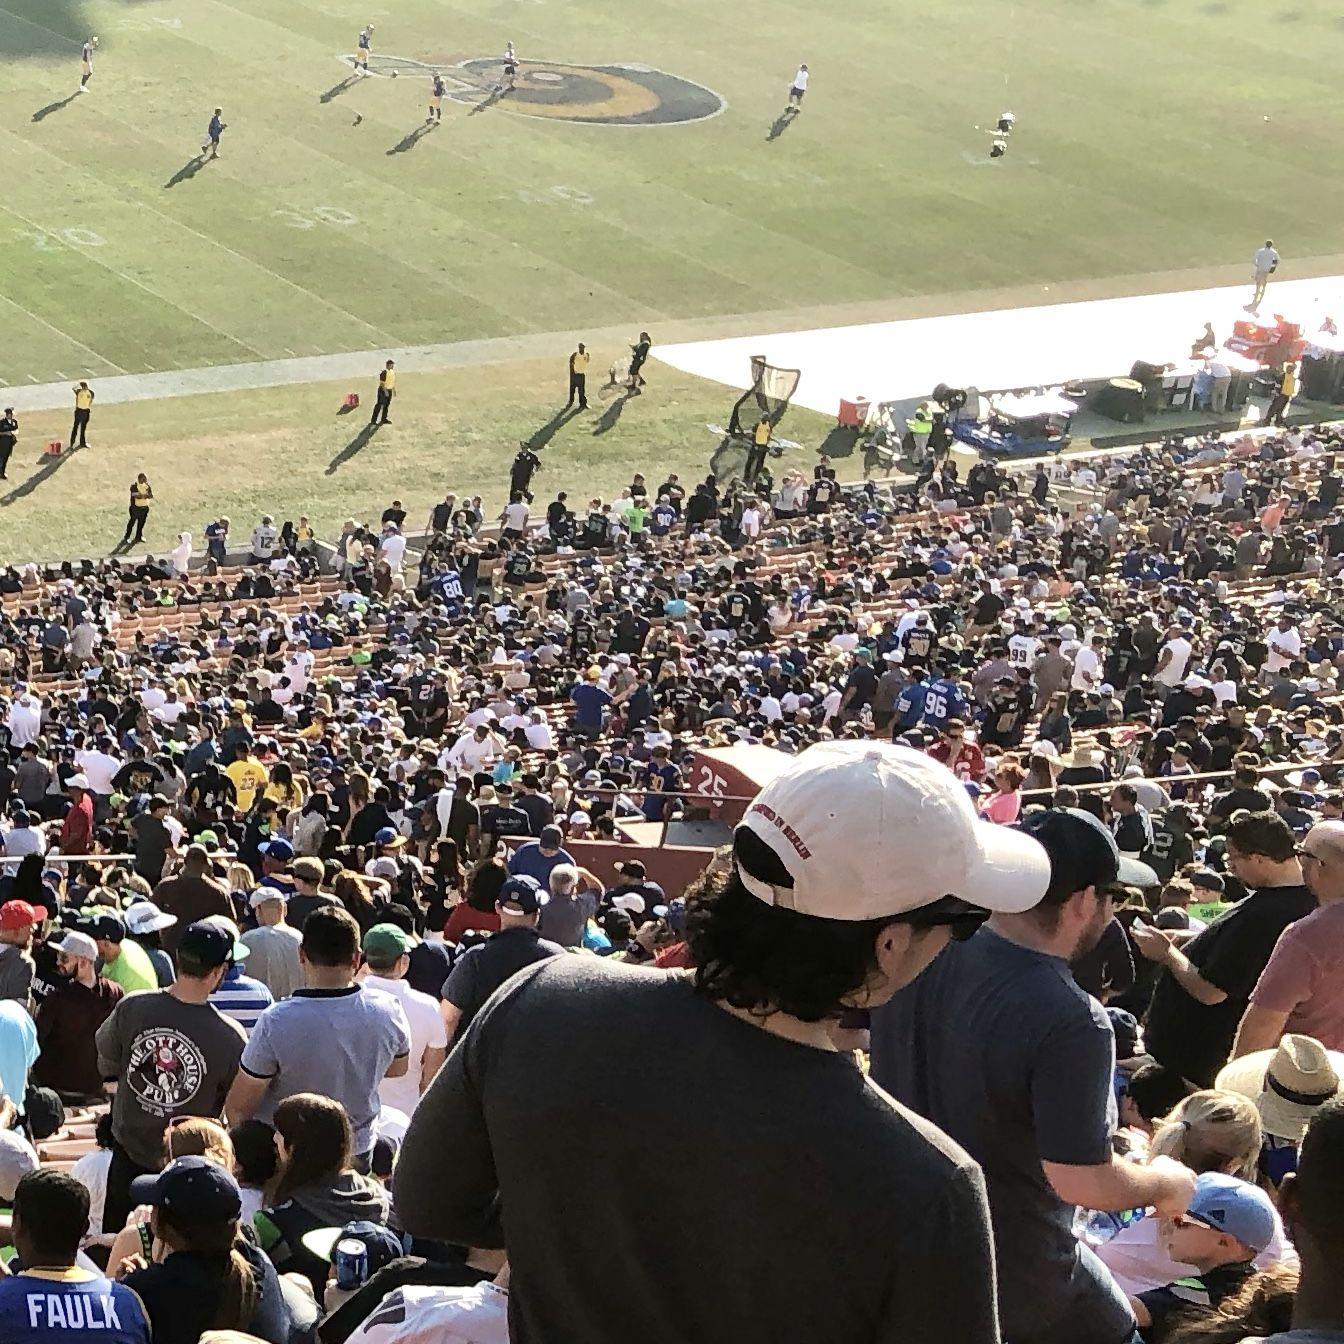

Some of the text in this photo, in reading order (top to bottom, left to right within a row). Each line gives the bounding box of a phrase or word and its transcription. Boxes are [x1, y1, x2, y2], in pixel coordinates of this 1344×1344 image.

[924, 691, 948, 718] 96
[697, 765, 728, 807] 25
[176, 1043, 199, 1093] HOUSE
[26, 1293, 123, 1331] FAULK
